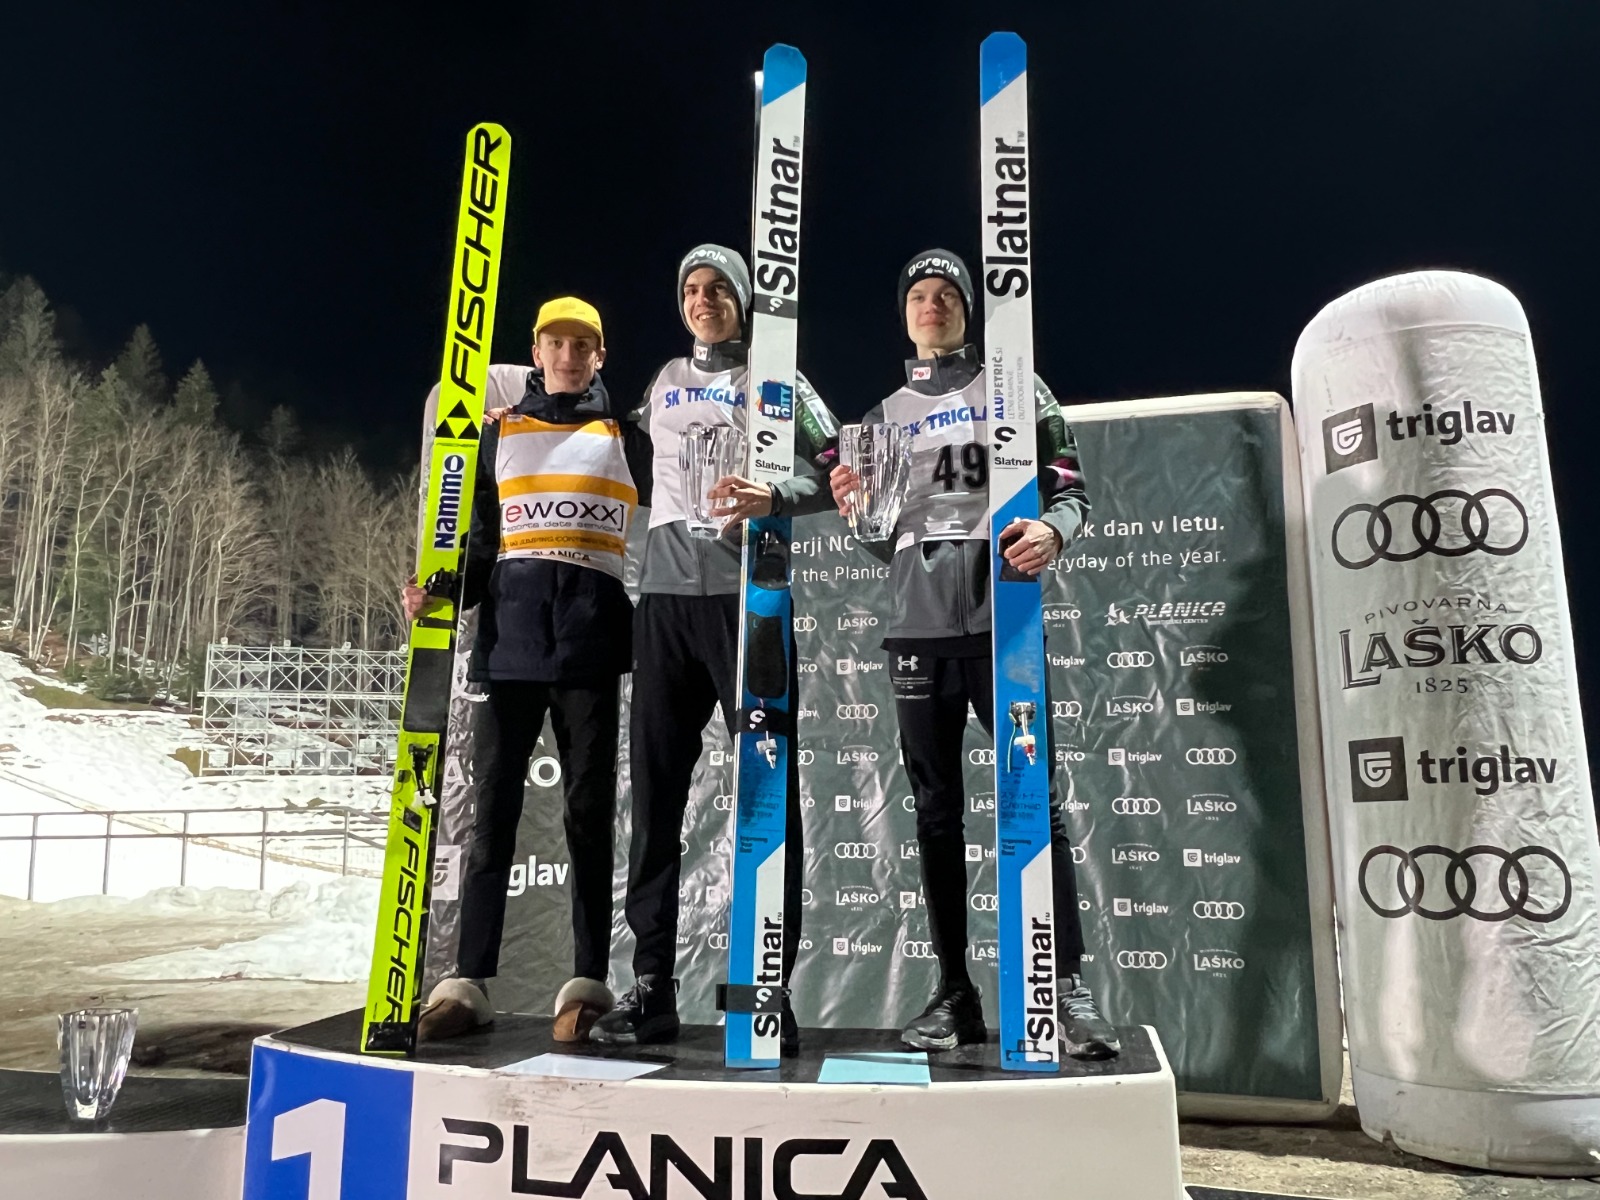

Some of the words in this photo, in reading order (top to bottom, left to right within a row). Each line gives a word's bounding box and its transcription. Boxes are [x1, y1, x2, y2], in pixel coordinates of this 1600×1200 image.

[756, 138, 800, 296] Slatnar
[986, 138, 1029, 299] Slatnar
[450, 127, 502, 396] FISCHER
[665, 388, 680, 408] SK
[685, 387, 746, 408] TRIGLA
[764, 404, 791, 418] BTC
[926, 405, 987, 431] TRIGL
[1385, 401, 1516, 445] triglav
[755, 458, 791, 473] Slatnar
[931, 443, 988, 492] 49
[994, 456, 1033, 467] Slatnar
[433, 454, 465, 551] Nammo
[1103, 519, 1143, 537] dan
[1152, 520, 1164, 535] v
[1173, 515, 1225, 533] letu.
[790, 537, 822, 557] erji
[1047, 552, 1108, 573] eryday
[1115, 552, 1134, 568] of
[1141, 550, 1173, 566] the
[1180, 549, 1227, 568] year.
[802, 568, 828, 583] the
[1043, 608, 1082, 622] AŠKO
[1133, 601, 1227, 619] PLANICA
[1364, 597, 1508, 625] PIVOVARNA
[1052, 655, 1085, 668] triglav
[1180, 650, 1229, 667] LAŠKO
[1339, 618, 1543, 690] LAŠKO
[1416, 677, 1469, 694] 1825
[1106, 700, 1154, 717] LAŠKO
[837, 750, 879, 765] LAŠKO
[1127, 751, 1163, 765] triglav
[1417, 745, 1557, 795] triglav
[970, 796, 994, 812] LAŠ
[1060, 800, 1090, 813] riglav
[1186, 798, 1237, 815] LAŠKO
[1111, 847, 1160, 864] LAŠKO
[1204, 852, 1241, 866] triglav
[506, 855, 569, 896] glav
[835, 890, 879, 906] LAŠKO
[1133, 902, 1169, 915] triglav
[850, 942, 883, 955] triglav
[1193, 953, 1246, 971] LAŠKO
[754, 916, 782, 1038] Stnar
[1026, 915, 1054, 1042] Slatnar
[271, 1097, 347, 1200] 1
[438, 1117, 930, 1200] PLANICA
